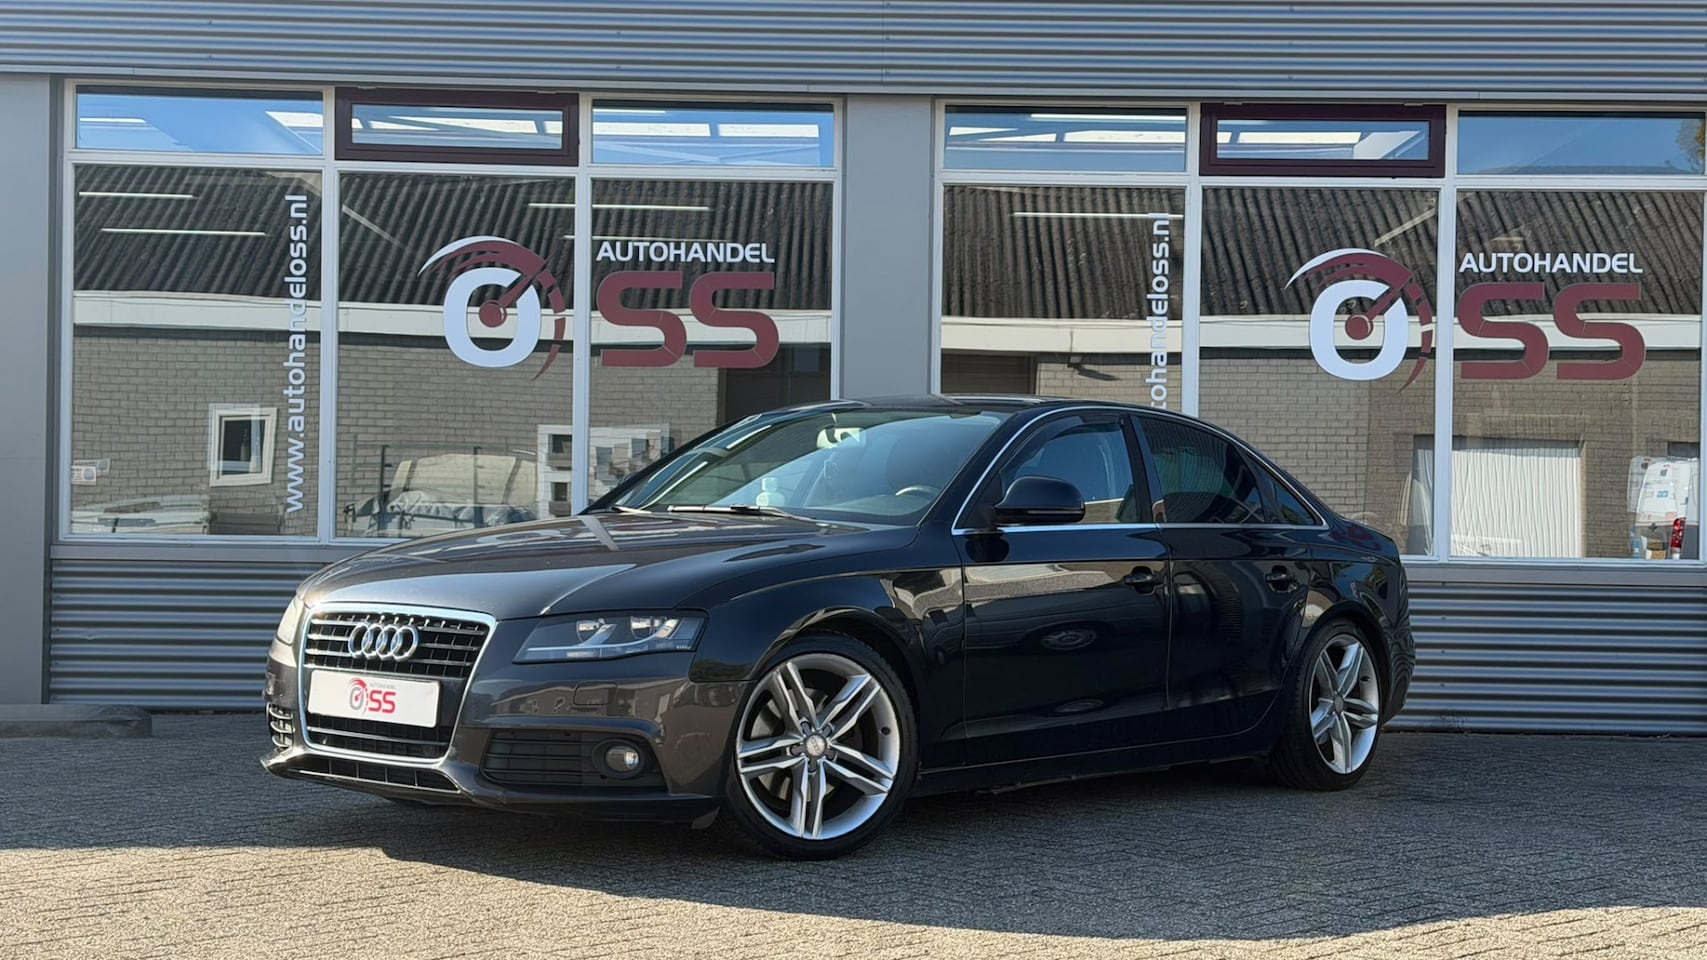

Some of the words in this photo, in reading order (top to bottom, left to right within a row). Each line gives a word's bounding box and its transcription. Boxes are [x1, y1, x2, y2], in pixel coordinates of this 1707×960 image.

[595, 241, 775, 263] AUTOHANDEL
[1459, 252, 1643, 273] AUTOHANDEL
[283, 195, 307, 514] www.autohandeloss.nl
